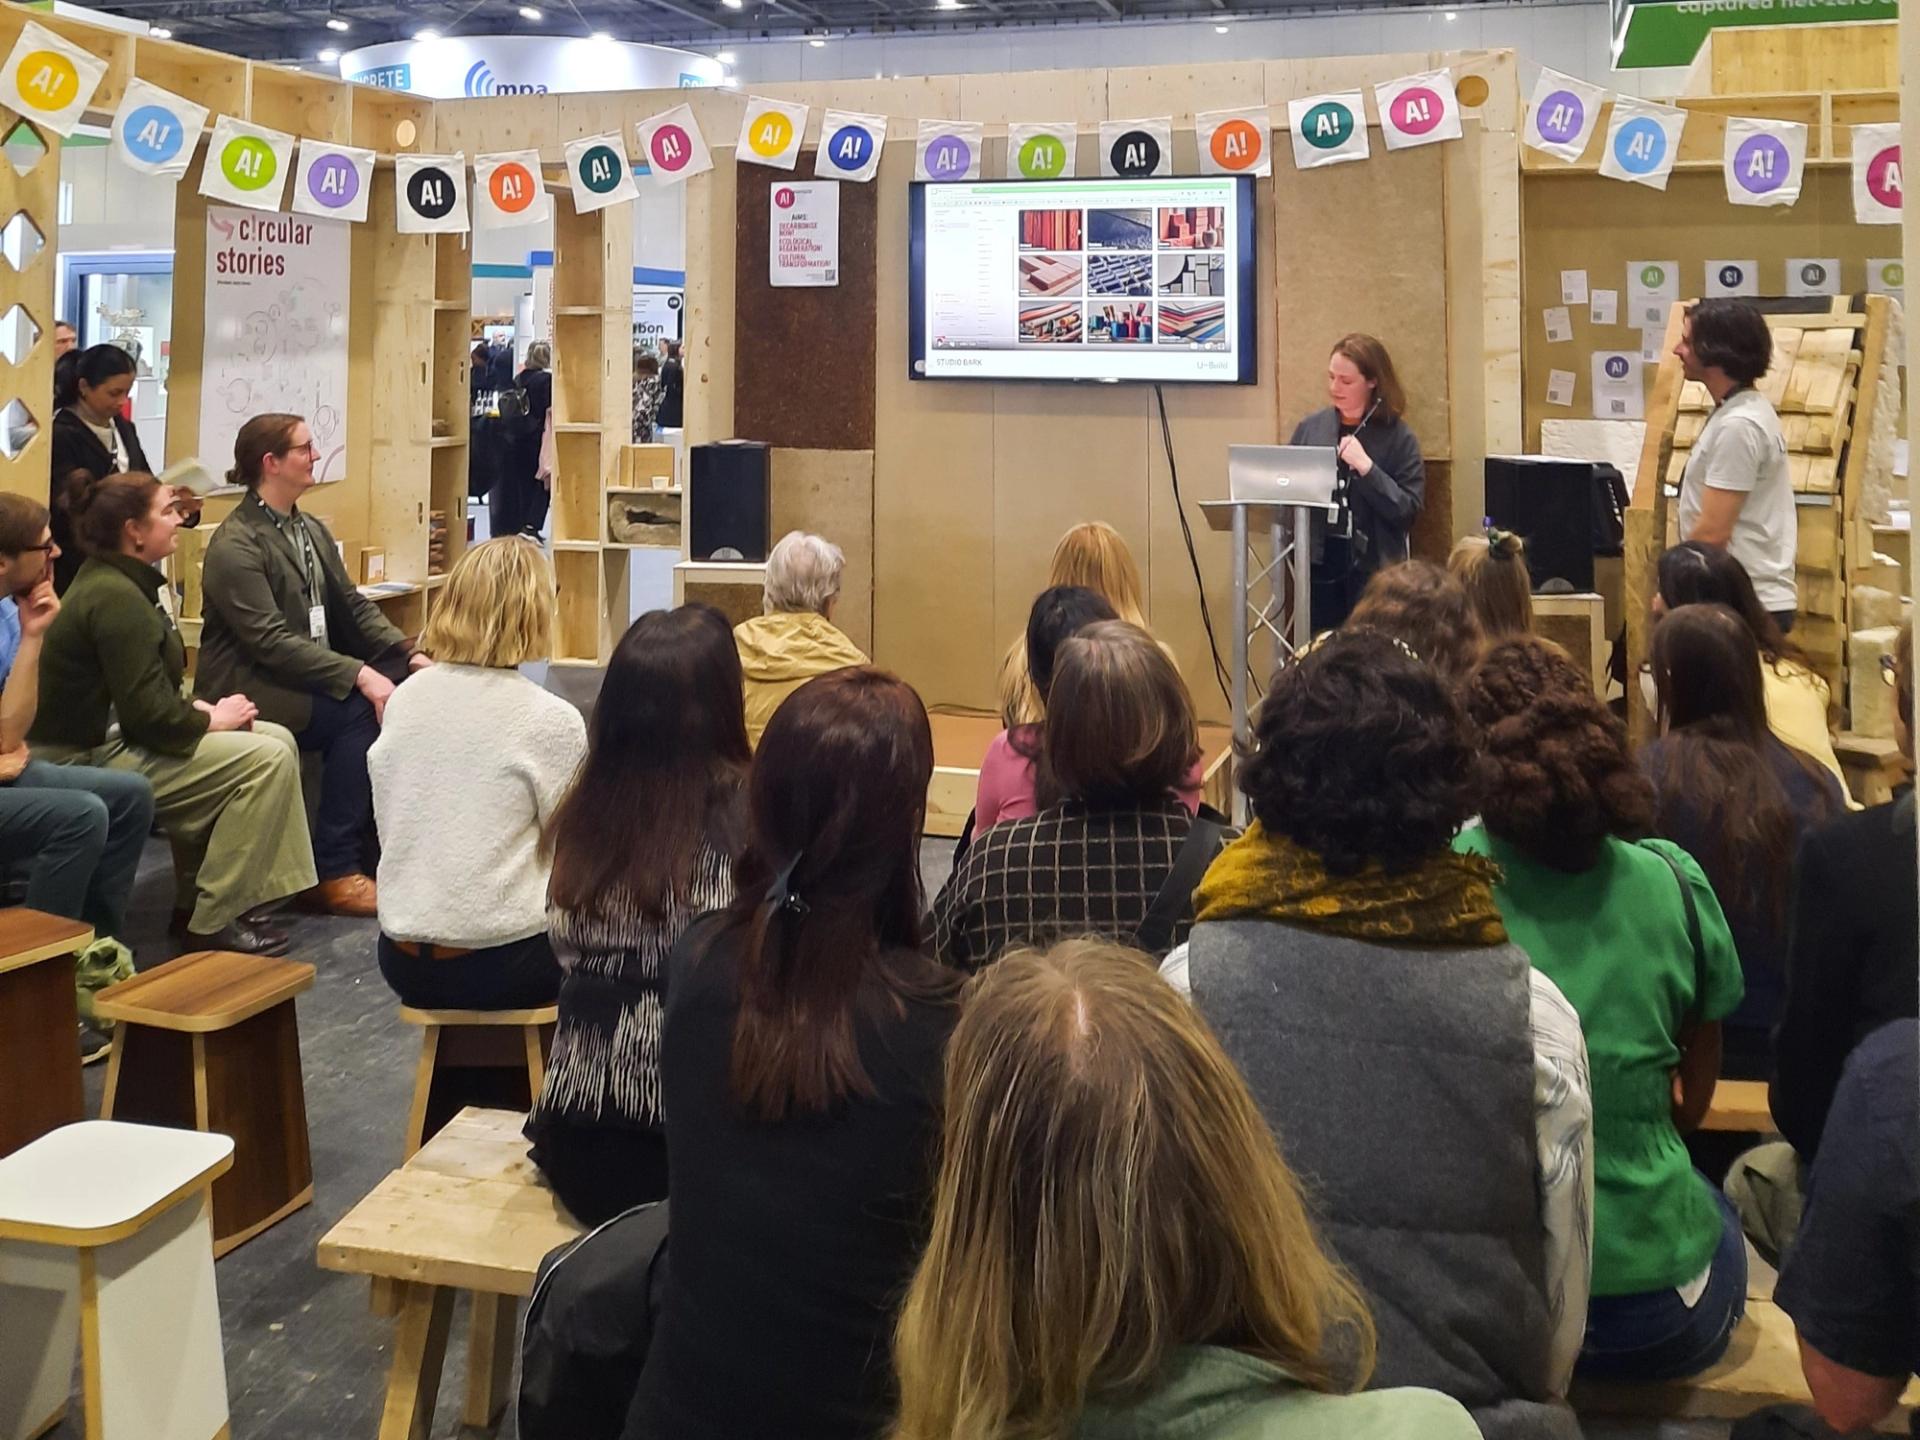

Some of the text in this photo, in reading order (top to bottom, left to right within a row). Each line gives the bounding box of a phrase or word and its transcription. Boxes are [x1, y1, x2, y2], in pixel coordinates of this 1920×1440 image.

[30, 64, 65, 97] A!
[1406, 96, 1430, 124] A!
[1546, 102, 1574, 133] A!
[136, 118, 172, 151] A!
[760, 122, 782, 146] A!
[1315, 112, 1340, 137] A!
[662, 134, 683, 162] A!
[839, 136, 862, 159] A!
[1031, 146, 1053, 170] A!
[1124, 142, 1146, 168] A!
[1225, 132, 1248, 158] A!
[1626, 130, 1655, 161] A!
[233, 148, 264, 178] A!
[592, 156, 612, 183] A!
[936, 147, 959, 171] A!
[1747, 149, 1775, 179] A!
[319, 166, 348, 195] A!
[420, 179, 444, 206] A!
[502, 175, 524, 201] A!
[217, 246, 285, 276] stories
